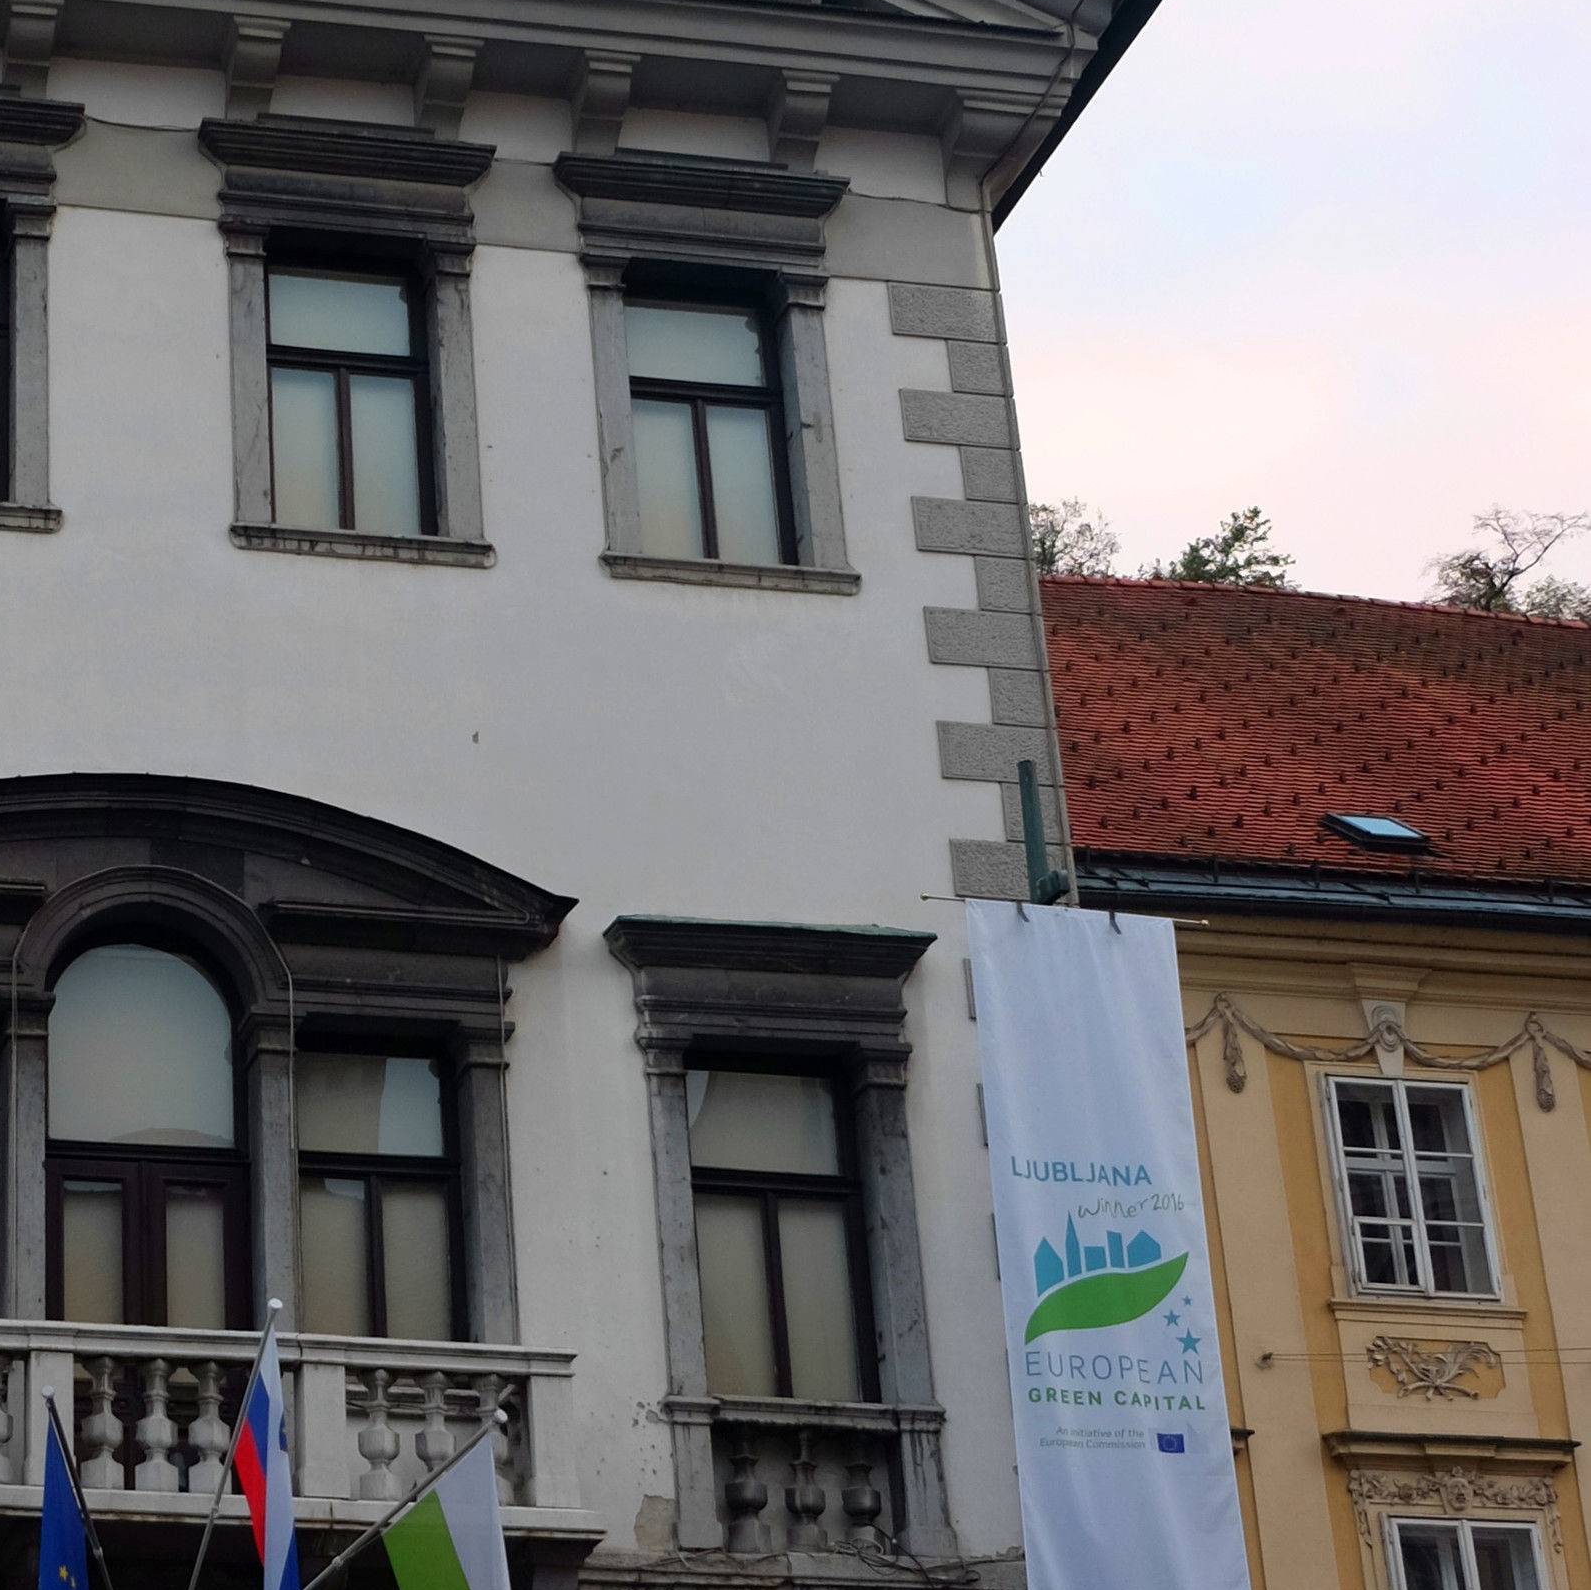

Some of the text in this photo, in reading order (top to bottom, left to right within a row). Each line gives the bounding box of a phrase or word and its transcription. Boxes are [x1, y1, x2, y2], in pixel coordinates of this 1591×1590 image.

[1011, 1155, 1153, 1186] LJUBLJANA
[1150, 1192, 1185, 1212] 2016
[1025, 1351, 1204, 1385] EUROPEAN
[1028, 1387, 1206, 1411] GREEN CAPITAL
[1056, 1426, 1068, 1436] An
[1114, 1429, 1126, 1438] of
[1127, 1429, 1145, 1438] the
[1040, 1438, 1146, 1450] European Commission
